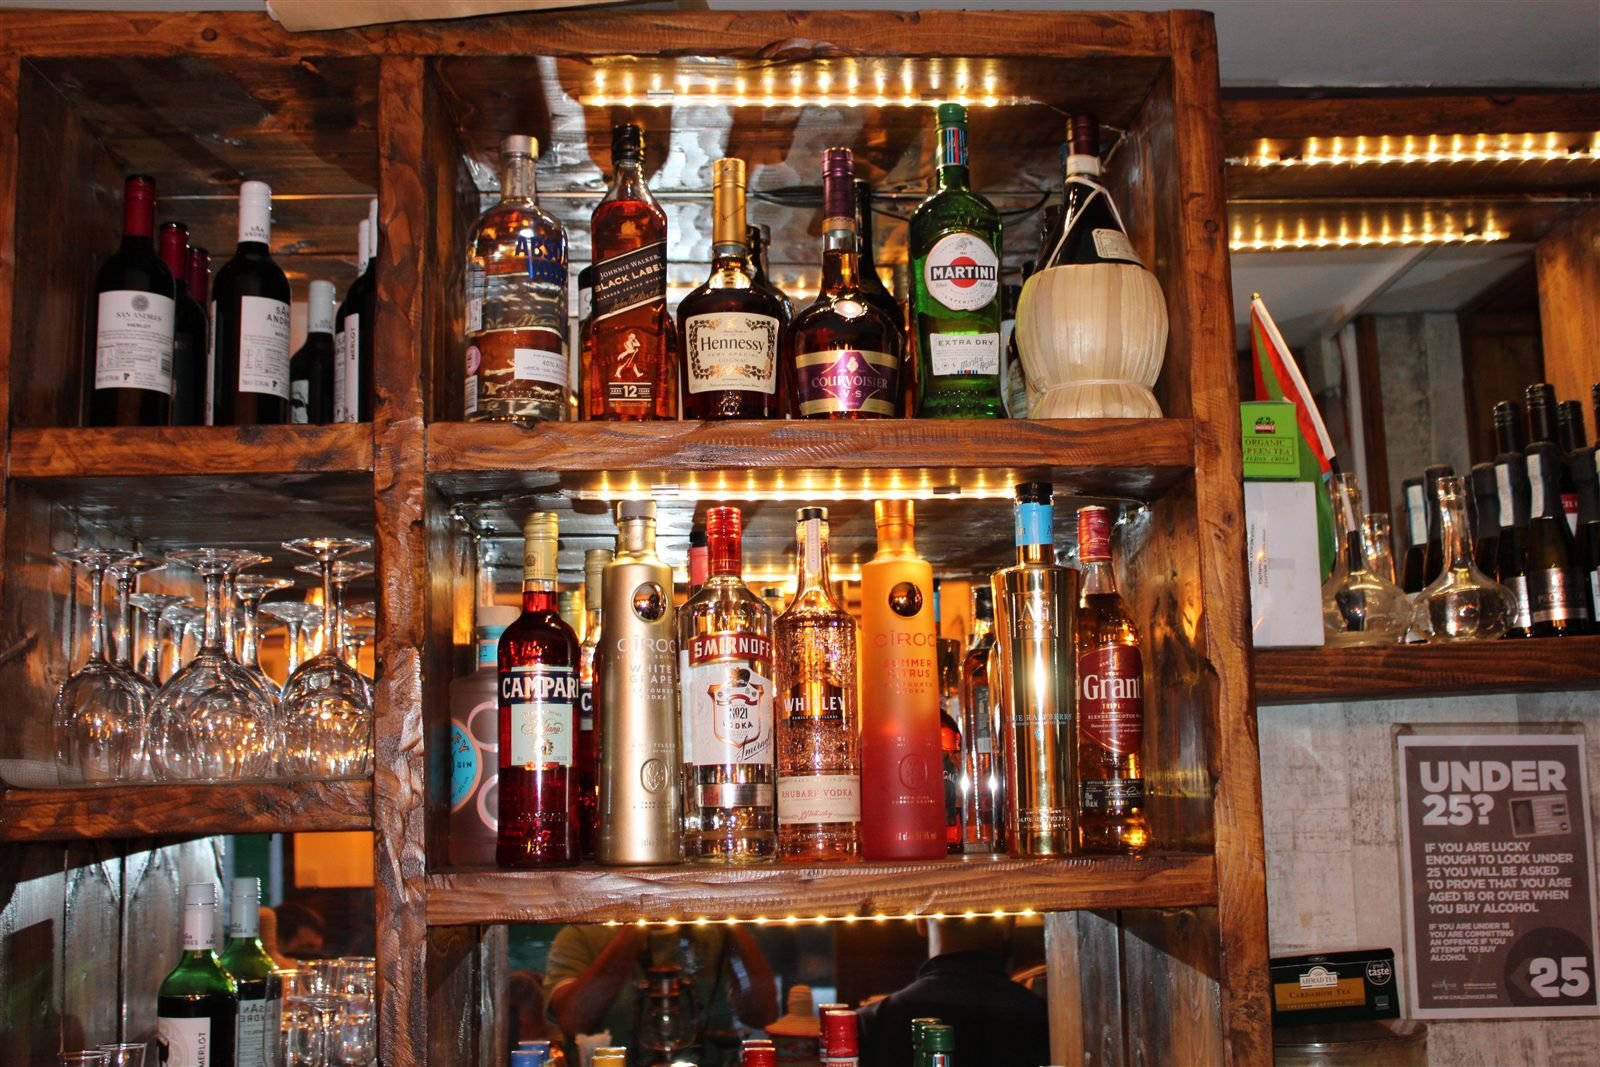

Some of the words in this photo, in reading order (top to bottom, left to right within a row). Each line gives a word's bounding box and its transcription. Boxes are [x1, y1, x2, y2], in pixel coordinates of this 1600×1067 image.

[595, 274, 630, 293] BLACK
[631, 263, 665, 280] LABEL
[599, 264, 631, 280] JOHNNIE
[933, 266, 994, 279] MARTINI
[701, 336, 765, 354] Hennessy
[938, 339, 971, 347] EXTRA
[811, 375, 889, 389] COURVOISIER
[622, 385, 638, 398] 12
[694, 636, 771, 658] SMIRNOFF
[630, 664, 672, 674] WHITE
[502, 676, 579, 699] CAMPARI
[784, 696, 844, 712] WHITLEY
[1419, 760, 1568, 793] UNDER
[823, 788, 853, 797] VODKA
[1422, 793, 1495, 826] 25?
[1425, 843, 1436, 853] IF
[1438, 842, 1462, 853] YOU
[1466, 842, 1490, 852] ARE
[1492, 842, 1531, 852] LUCKY
[1425, 855, 1476, 865] ENOUGH
[1479, 854, 1495, 864] TO
[1497, 854, 1530, 864] LOOK
[1532, 853, 1574, 863] UNDER
[1426, 867, 1440, 877] 25
[1443, 867, 1467, 877] YOU
[1470, 866, 1499, 876] WILL
[1502, 866, 1518, 876] BE
[1520, 865, 1560, 876] ASKED
[1427, 879, 1444, 890] TO
[1446, 879, 1486, 889] PROVE
[1488, 878, 1518, 888] THAT
[1521, 878, 1545, 888] YOU
[1547, 877, 1572, 887] ARE
[1428, 892, 1461, 902] AGED
[1463, 891, 1475, 901] 18
[1477, 891, 1495, 901] OR
[1497, 890, 1529, 901] OVER
[1531, 890, 1569, 900] WHEN
[1428, 904, 1453, 914] YOU
[1456, 903, 1481, 913] BUY
[1483, 903, 1539, 913] ALCOHOL
[1473, 922, 1500, 930] UNDER
[1368, 968, 1390, 976] taste
[1529, 956, 1590, 998] 25
[1301, 977, 1324, 985] AHMAD
[198, 1032, 206, 1067] MERLOT
